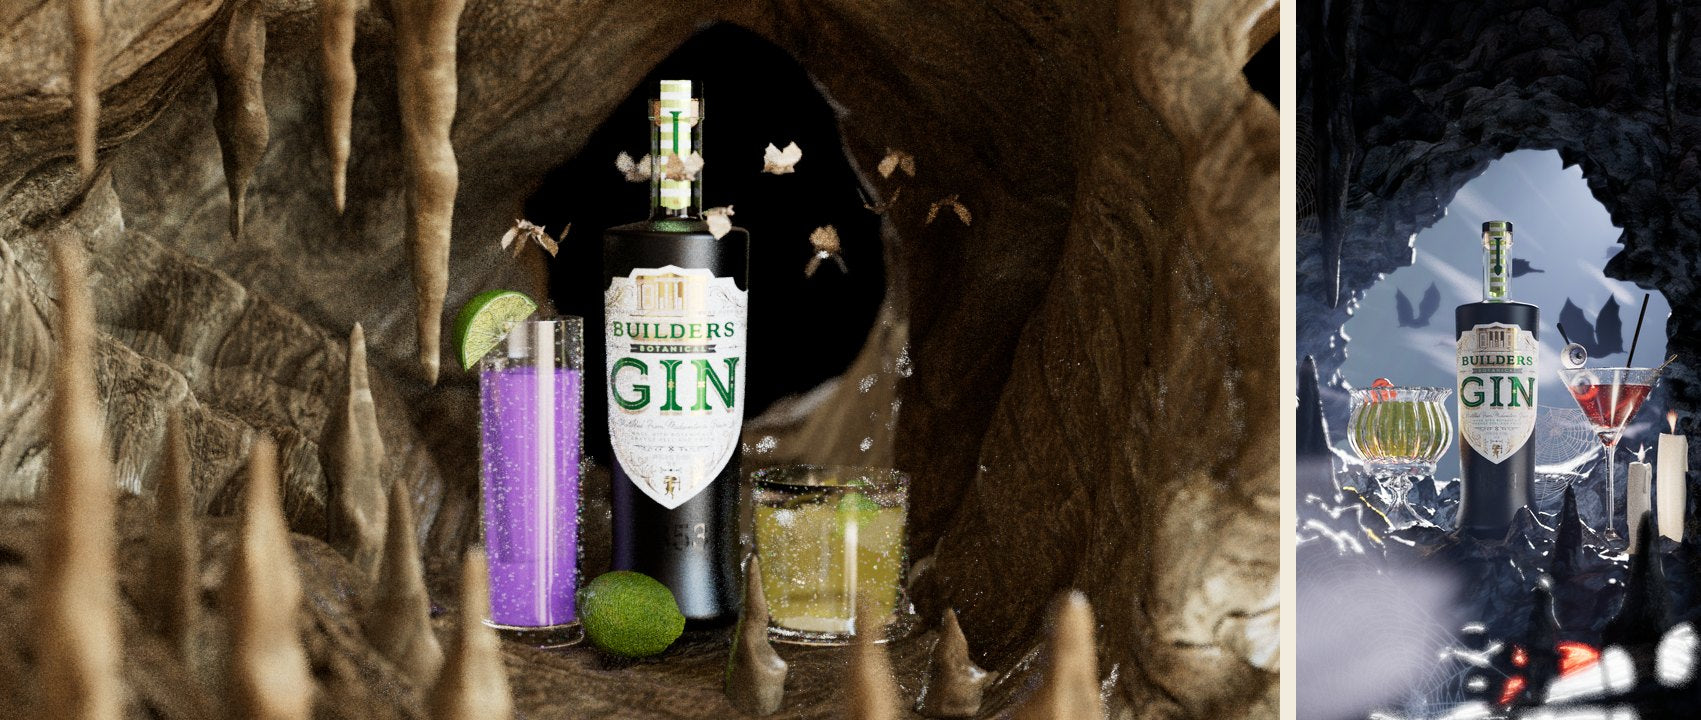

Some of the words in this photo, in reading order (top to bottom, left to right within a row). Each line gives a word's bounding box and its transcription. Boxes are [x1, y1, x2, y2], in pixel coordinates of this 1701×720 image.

[613, 321, 735, 339] BUILDERS
[639, 345, 707, 353] BOTANICAL
[1462, 355, 1533, 366] BUILDERS
[611, 357, 740, 412] GIN
[1460, 376, 1536, 408] GIN
